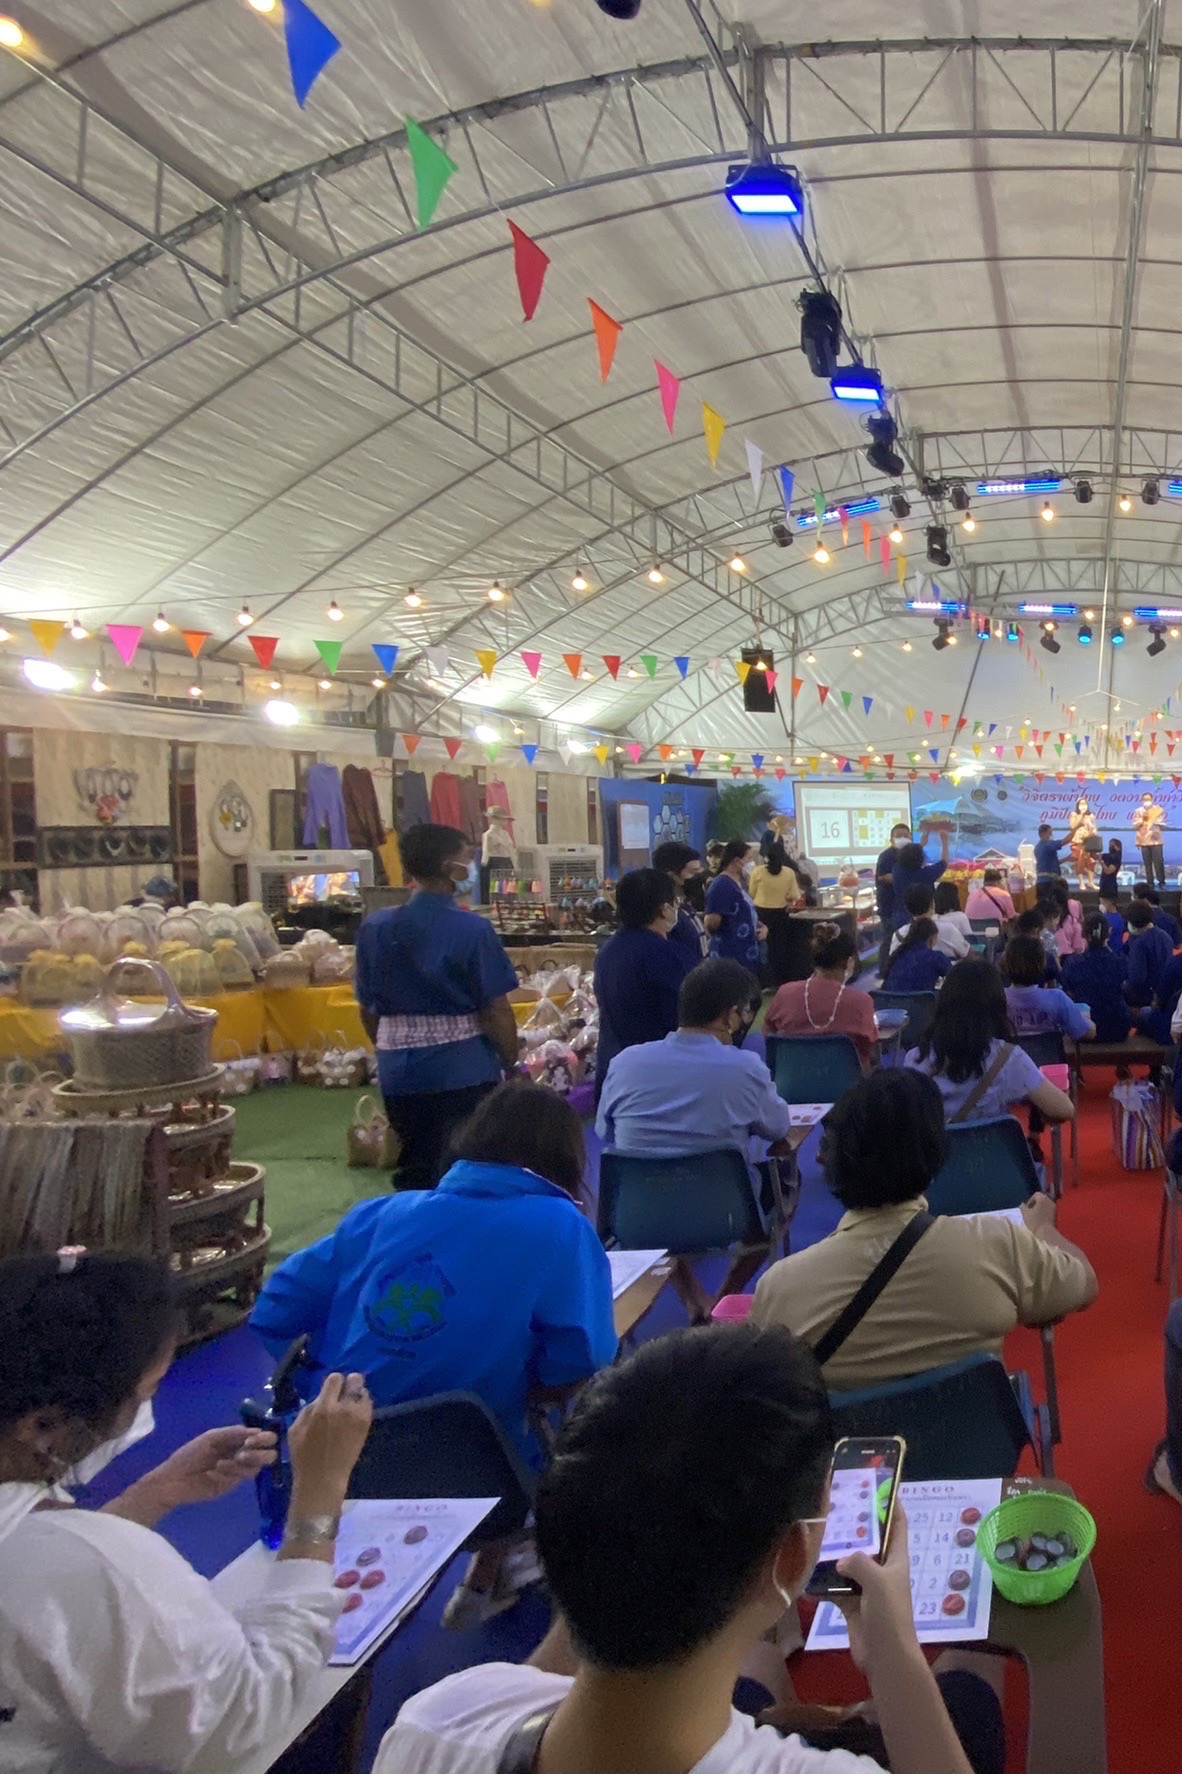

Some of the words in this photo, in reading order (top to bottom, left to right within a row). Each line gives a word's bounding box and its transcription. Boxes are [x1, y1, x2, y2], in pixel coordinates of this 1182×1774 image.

[820, 821, 841, 839] 16
[902, 1486, 955, 1494] BINGO
[914, 1512, 929, 1523] 25
[933, 1531, 949, 1544] 14
[934, 1554, 942, 1565] 6
[955, 1553, 970, 1564] 21
[918, 1603, 937, 1615] 23
